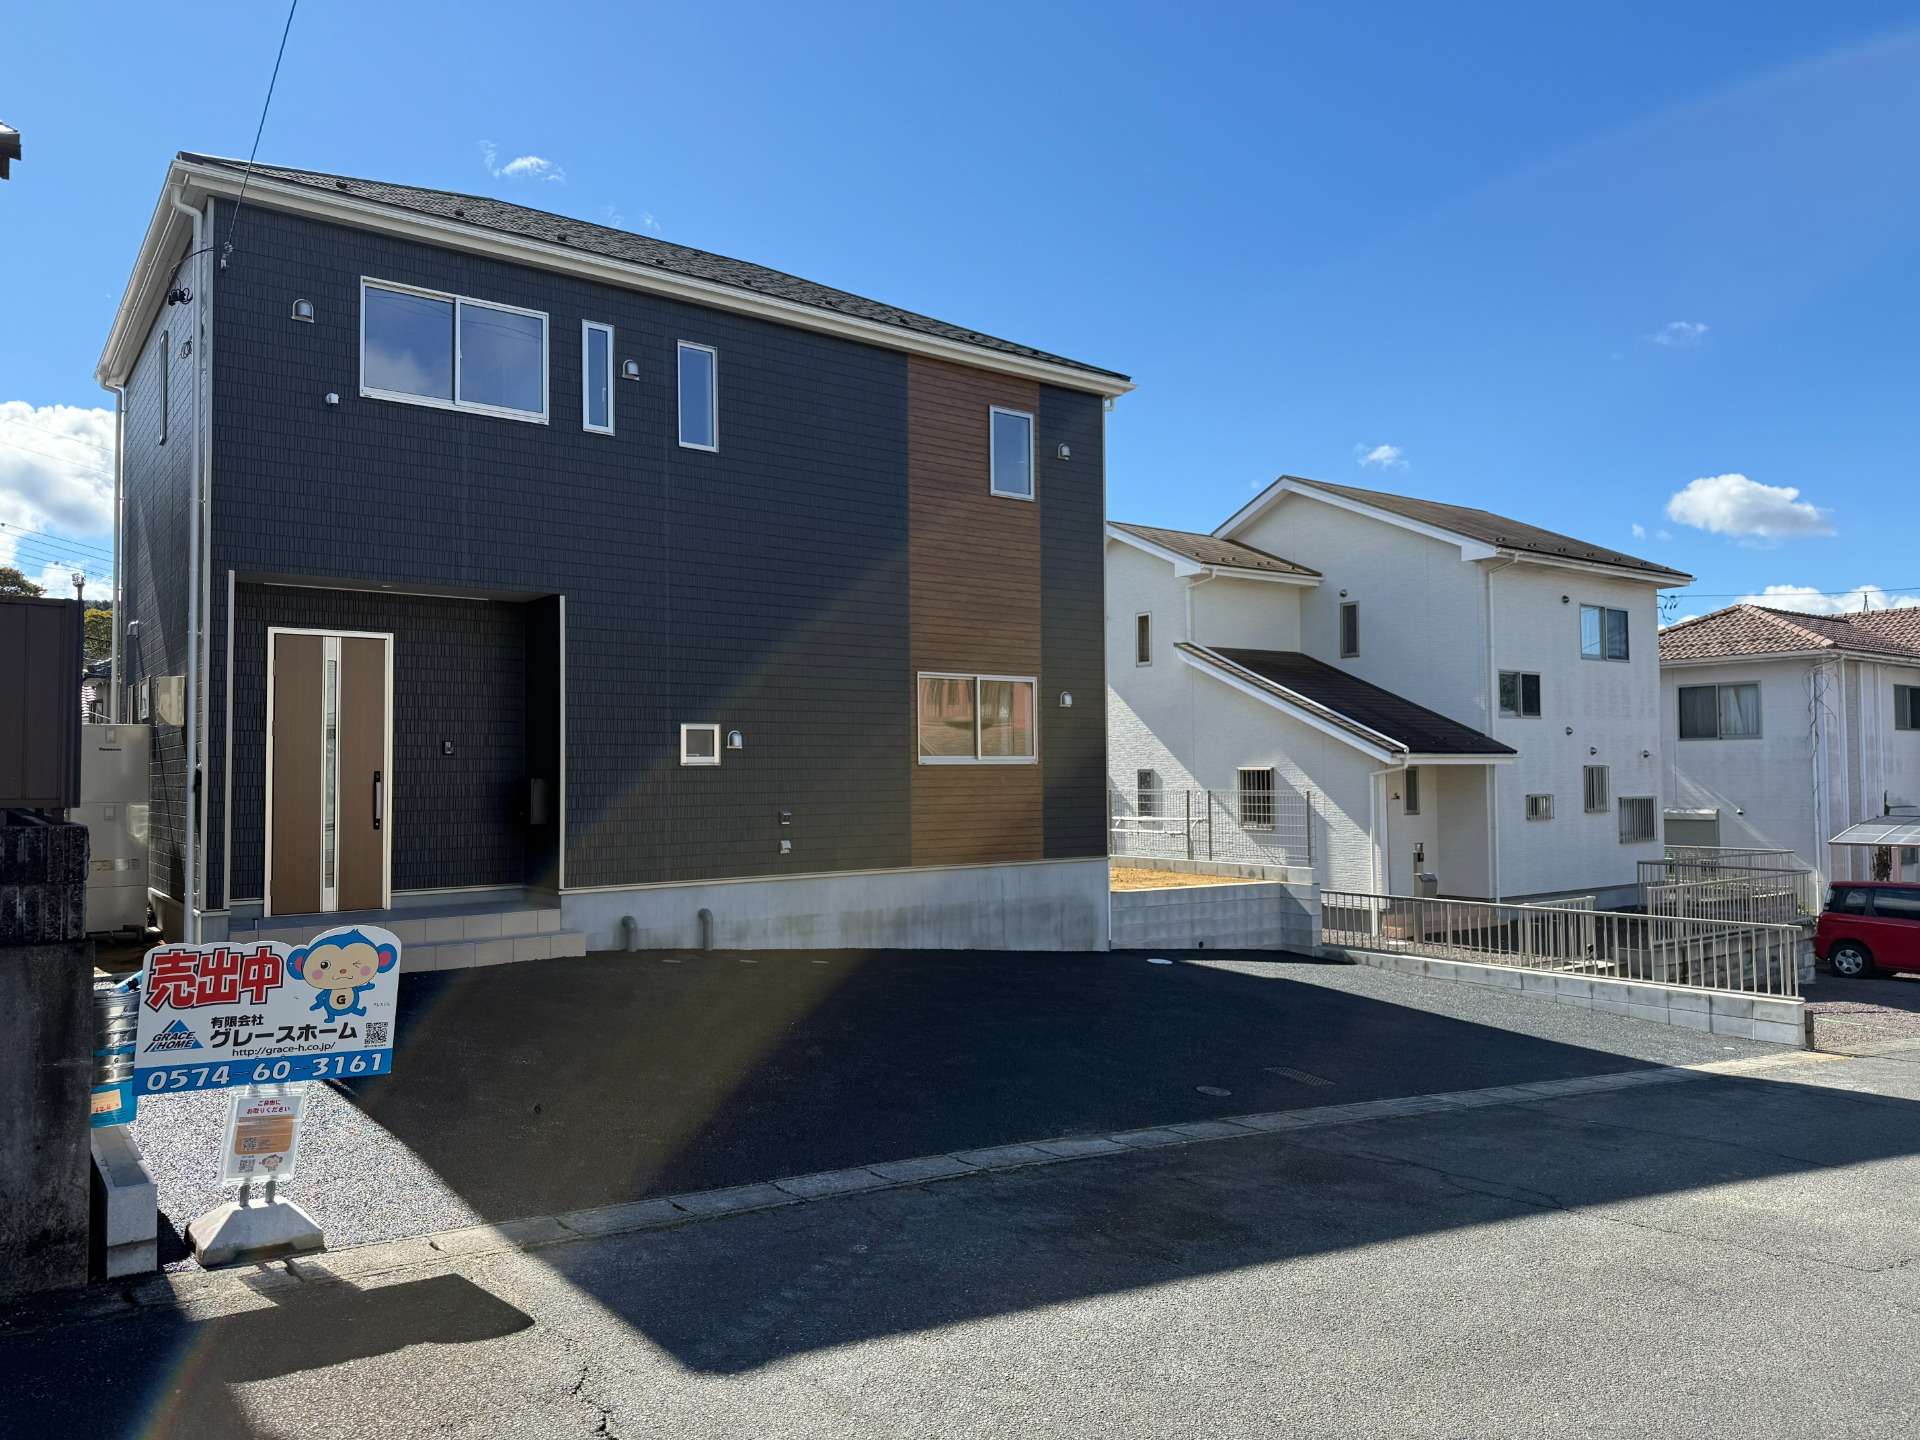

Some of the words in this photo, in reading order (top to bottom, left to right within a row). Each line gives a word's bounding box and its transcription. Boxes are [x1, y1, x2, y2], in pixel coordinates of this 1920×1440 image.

[145, 946, 283, 1012] 売出中
[337, 994, 346, 1005] G
[211, 1014, 264, 1029] 有限会社
[153, 1031, 195, 1042] GRACE
[210, 1022, 358, 1049] グレースホーム
[159, 1040, 194, 1050] HOME
[232, 1042, 336, 1056] http://grace-h.co.jp/
[147, 1065, 230, 1091] 0574
[252, 1061, 291, 1081] 60
[312, 1053, 382, 1076] 3161
